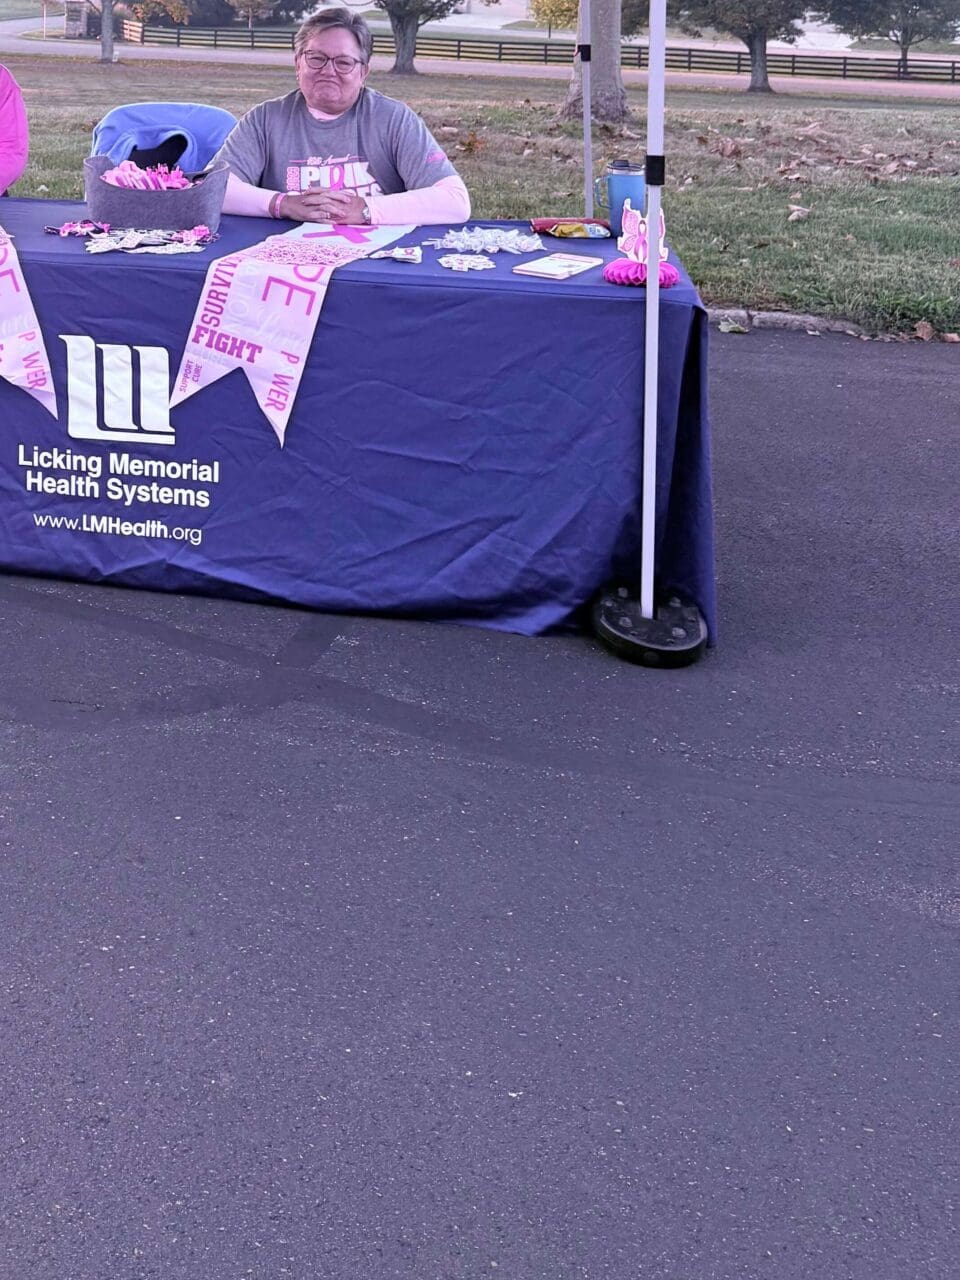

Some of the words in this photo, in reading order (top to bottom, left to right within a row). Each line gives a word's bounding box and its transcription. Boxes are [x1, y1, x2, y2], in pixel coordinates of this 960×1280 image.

[192, 324, 263, 364] FIGHT
[179, 359, 194, 393] SUPPORT
[192, 362, 203, 383] CURE
[18, 444, 102, 478] Licking
[109, 453, 220, 483] Memorial
[26, 470, 100, 498] Health
[106, 478, 210, 508] Systems
[33, 513, 202, 546] www.LMHealth.org
